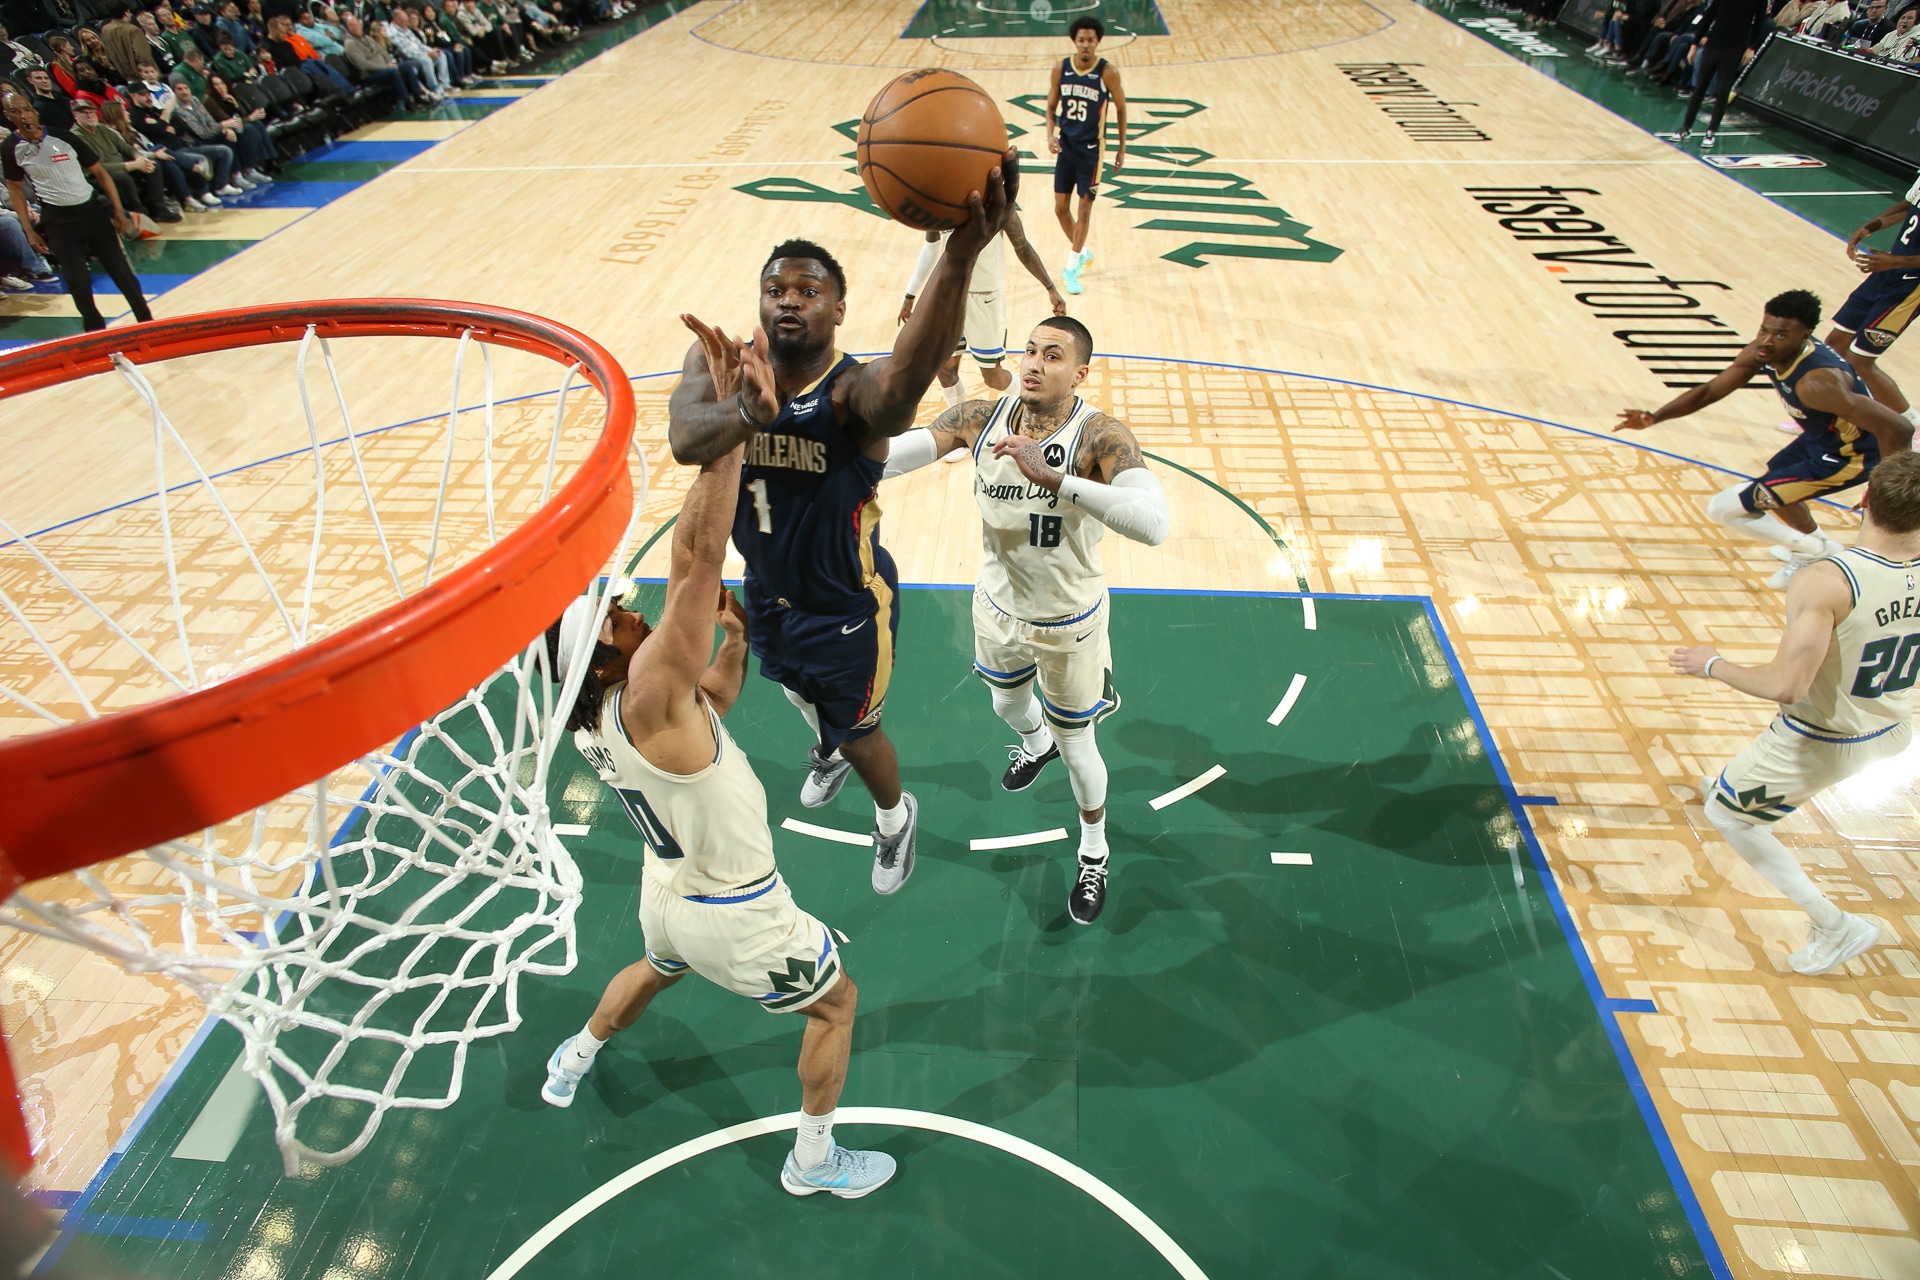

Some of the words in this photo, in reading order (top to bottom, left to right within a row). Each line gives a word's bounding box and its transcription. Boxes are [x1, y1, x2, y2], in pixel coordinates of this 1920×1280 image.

[1067, 99, 1088, 122] 25
[1832, 84, 1881, 118] Save
[746, 478, 772, 534] 1
[1029, 513, 1063, 548] 18
[1850, 633, 1920, 699] 20
[582, 746, 617, 773] SIMS
